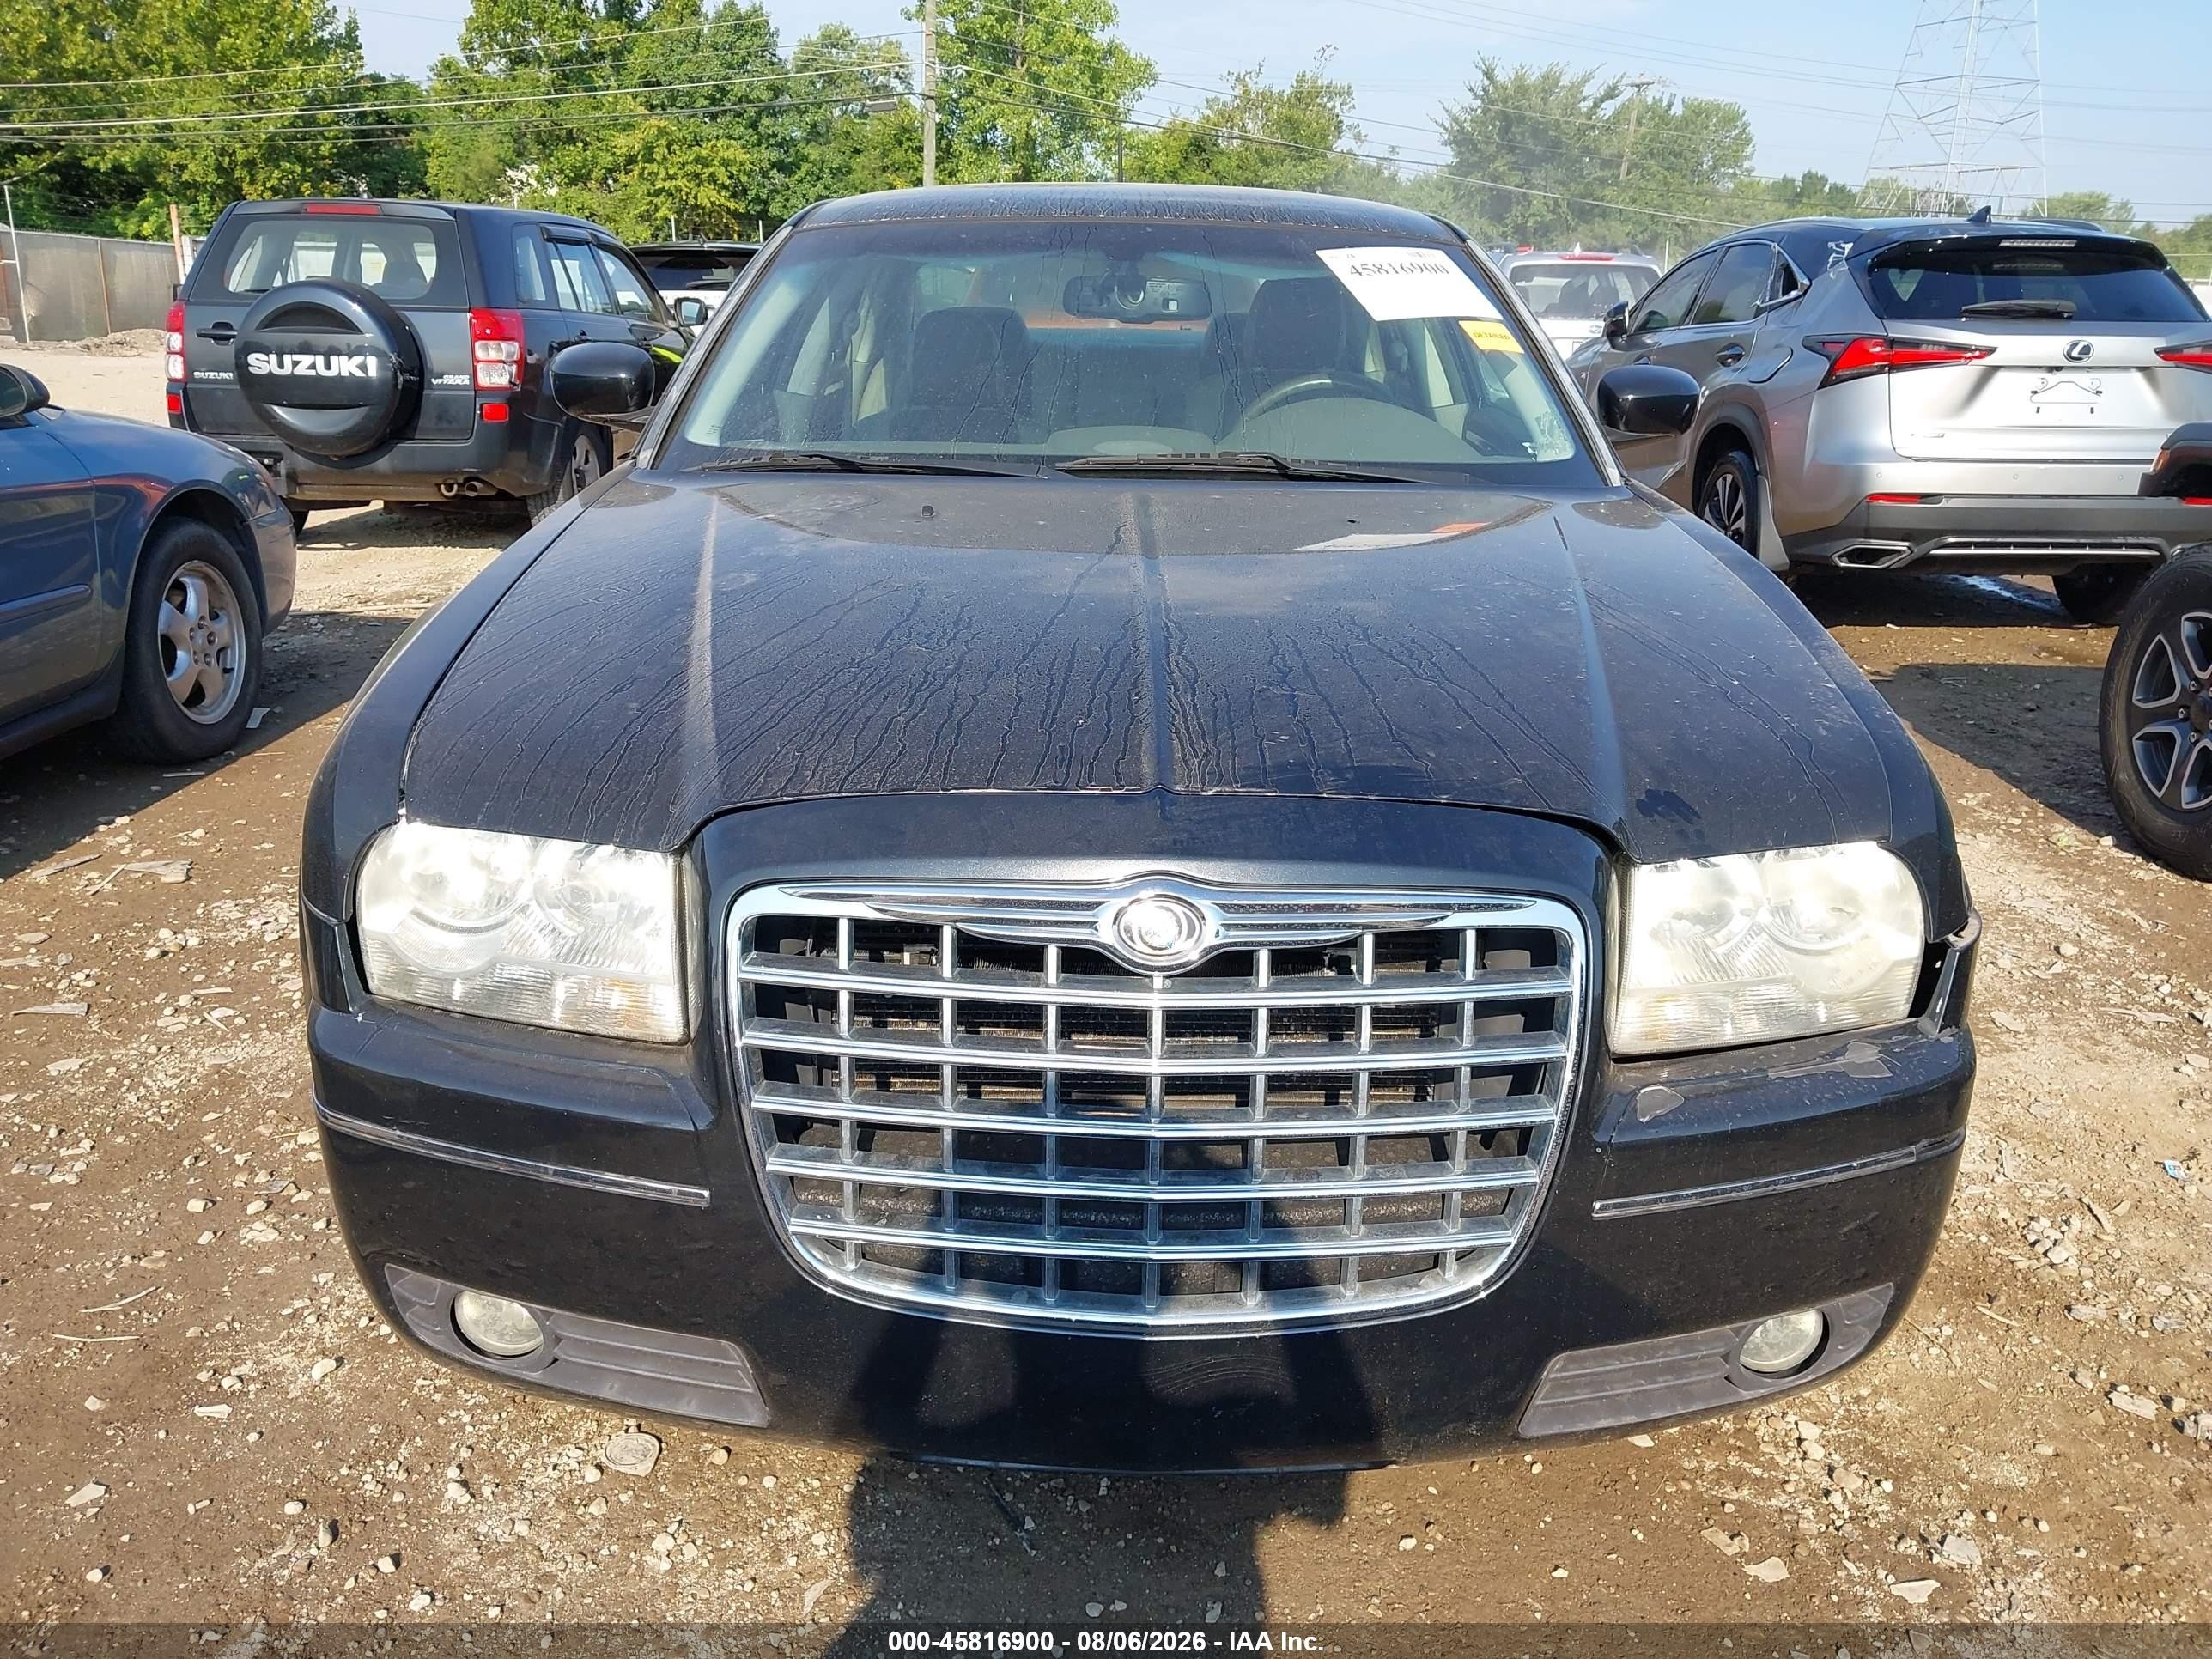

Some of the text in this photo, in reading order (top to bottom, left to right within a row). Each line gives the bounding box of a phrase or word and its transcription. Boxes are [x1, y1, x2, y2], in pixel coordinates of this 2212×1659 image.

[1350, 262, 1450, 276] 45816900
[247, 352, 378, 379] SUZUKI
[192, 371, 234, 380] SUZUKI
